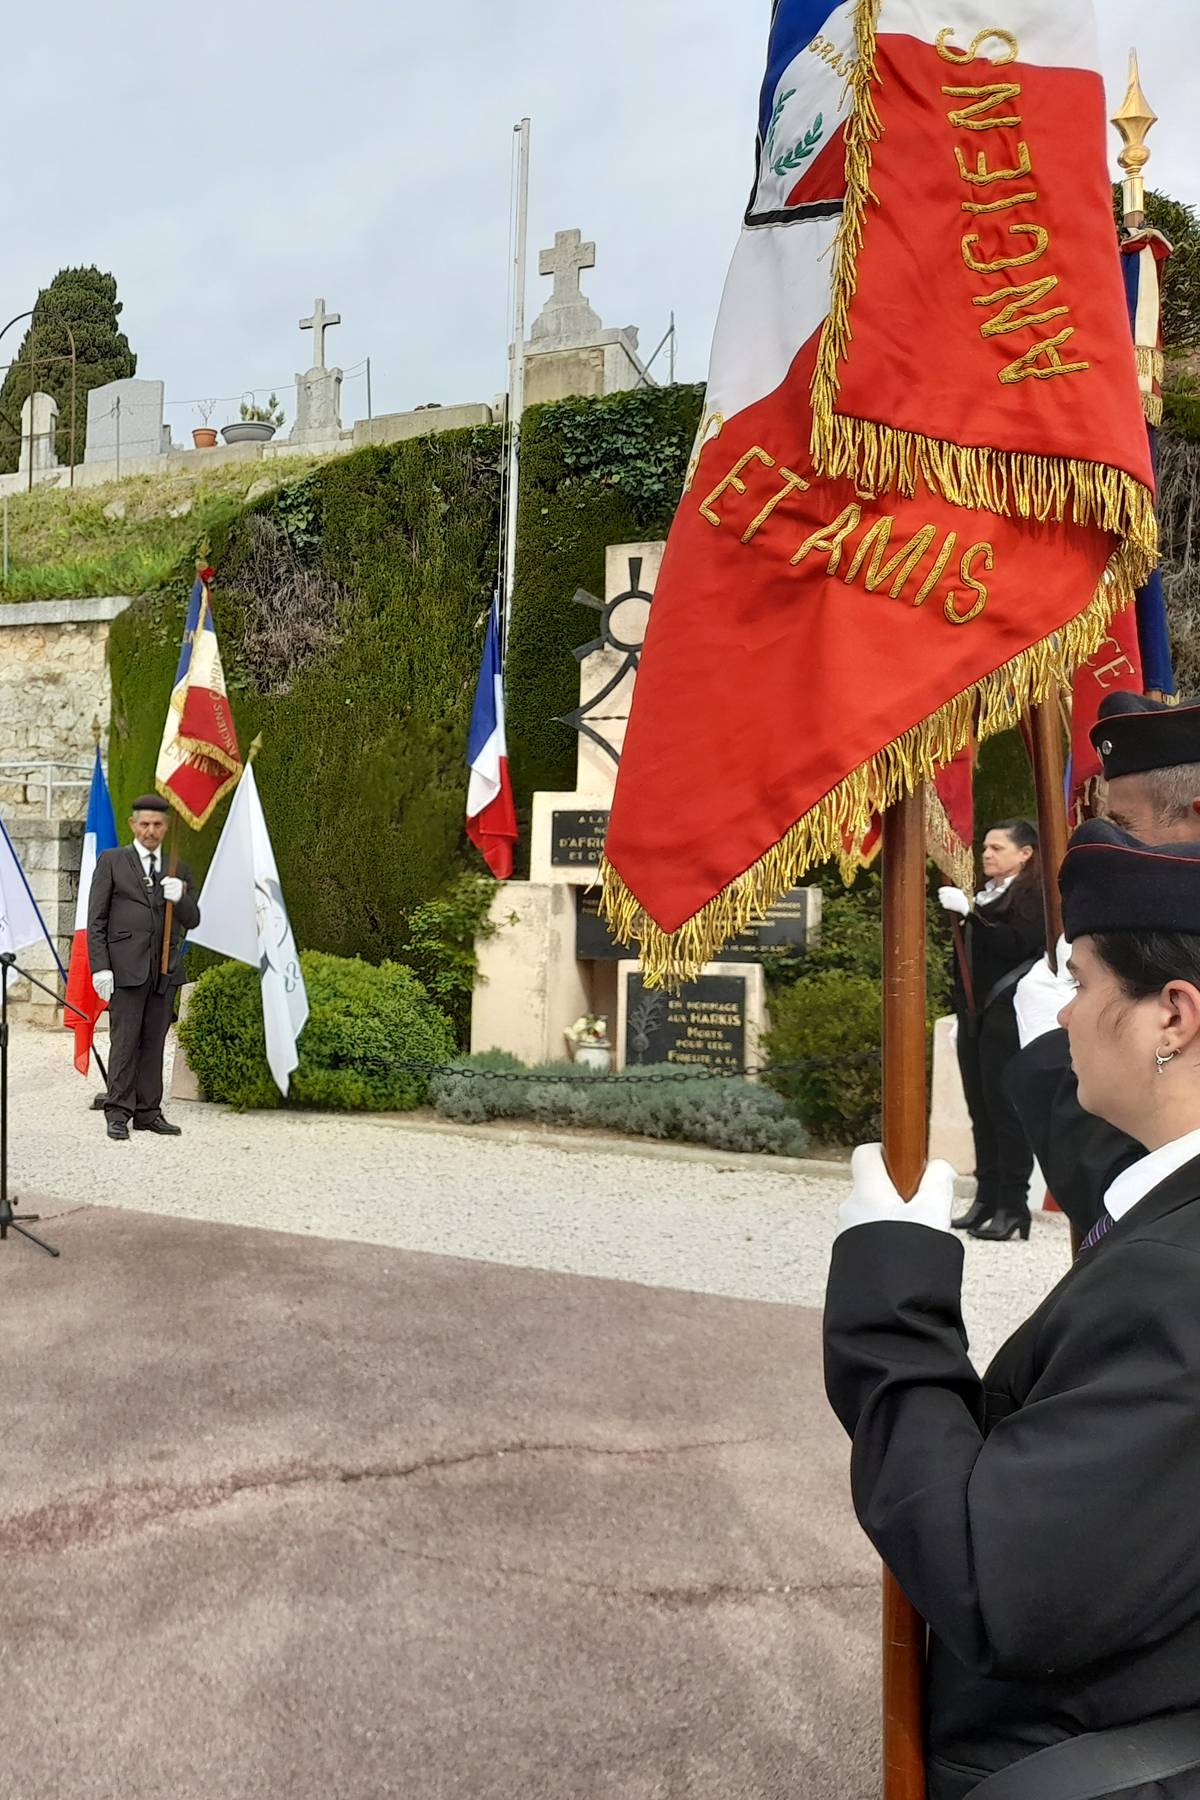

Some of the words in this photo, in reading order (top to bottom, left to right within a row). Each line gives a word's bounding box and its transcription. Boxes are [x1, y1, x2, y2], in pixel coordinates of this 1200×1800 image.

[934, 26, 1090, 384] ANCIENS
[698, 445, 810, 545] ET
[789, 501, 994, 625] AMIS
[690, 1012, 742, 1027] HARKIS
